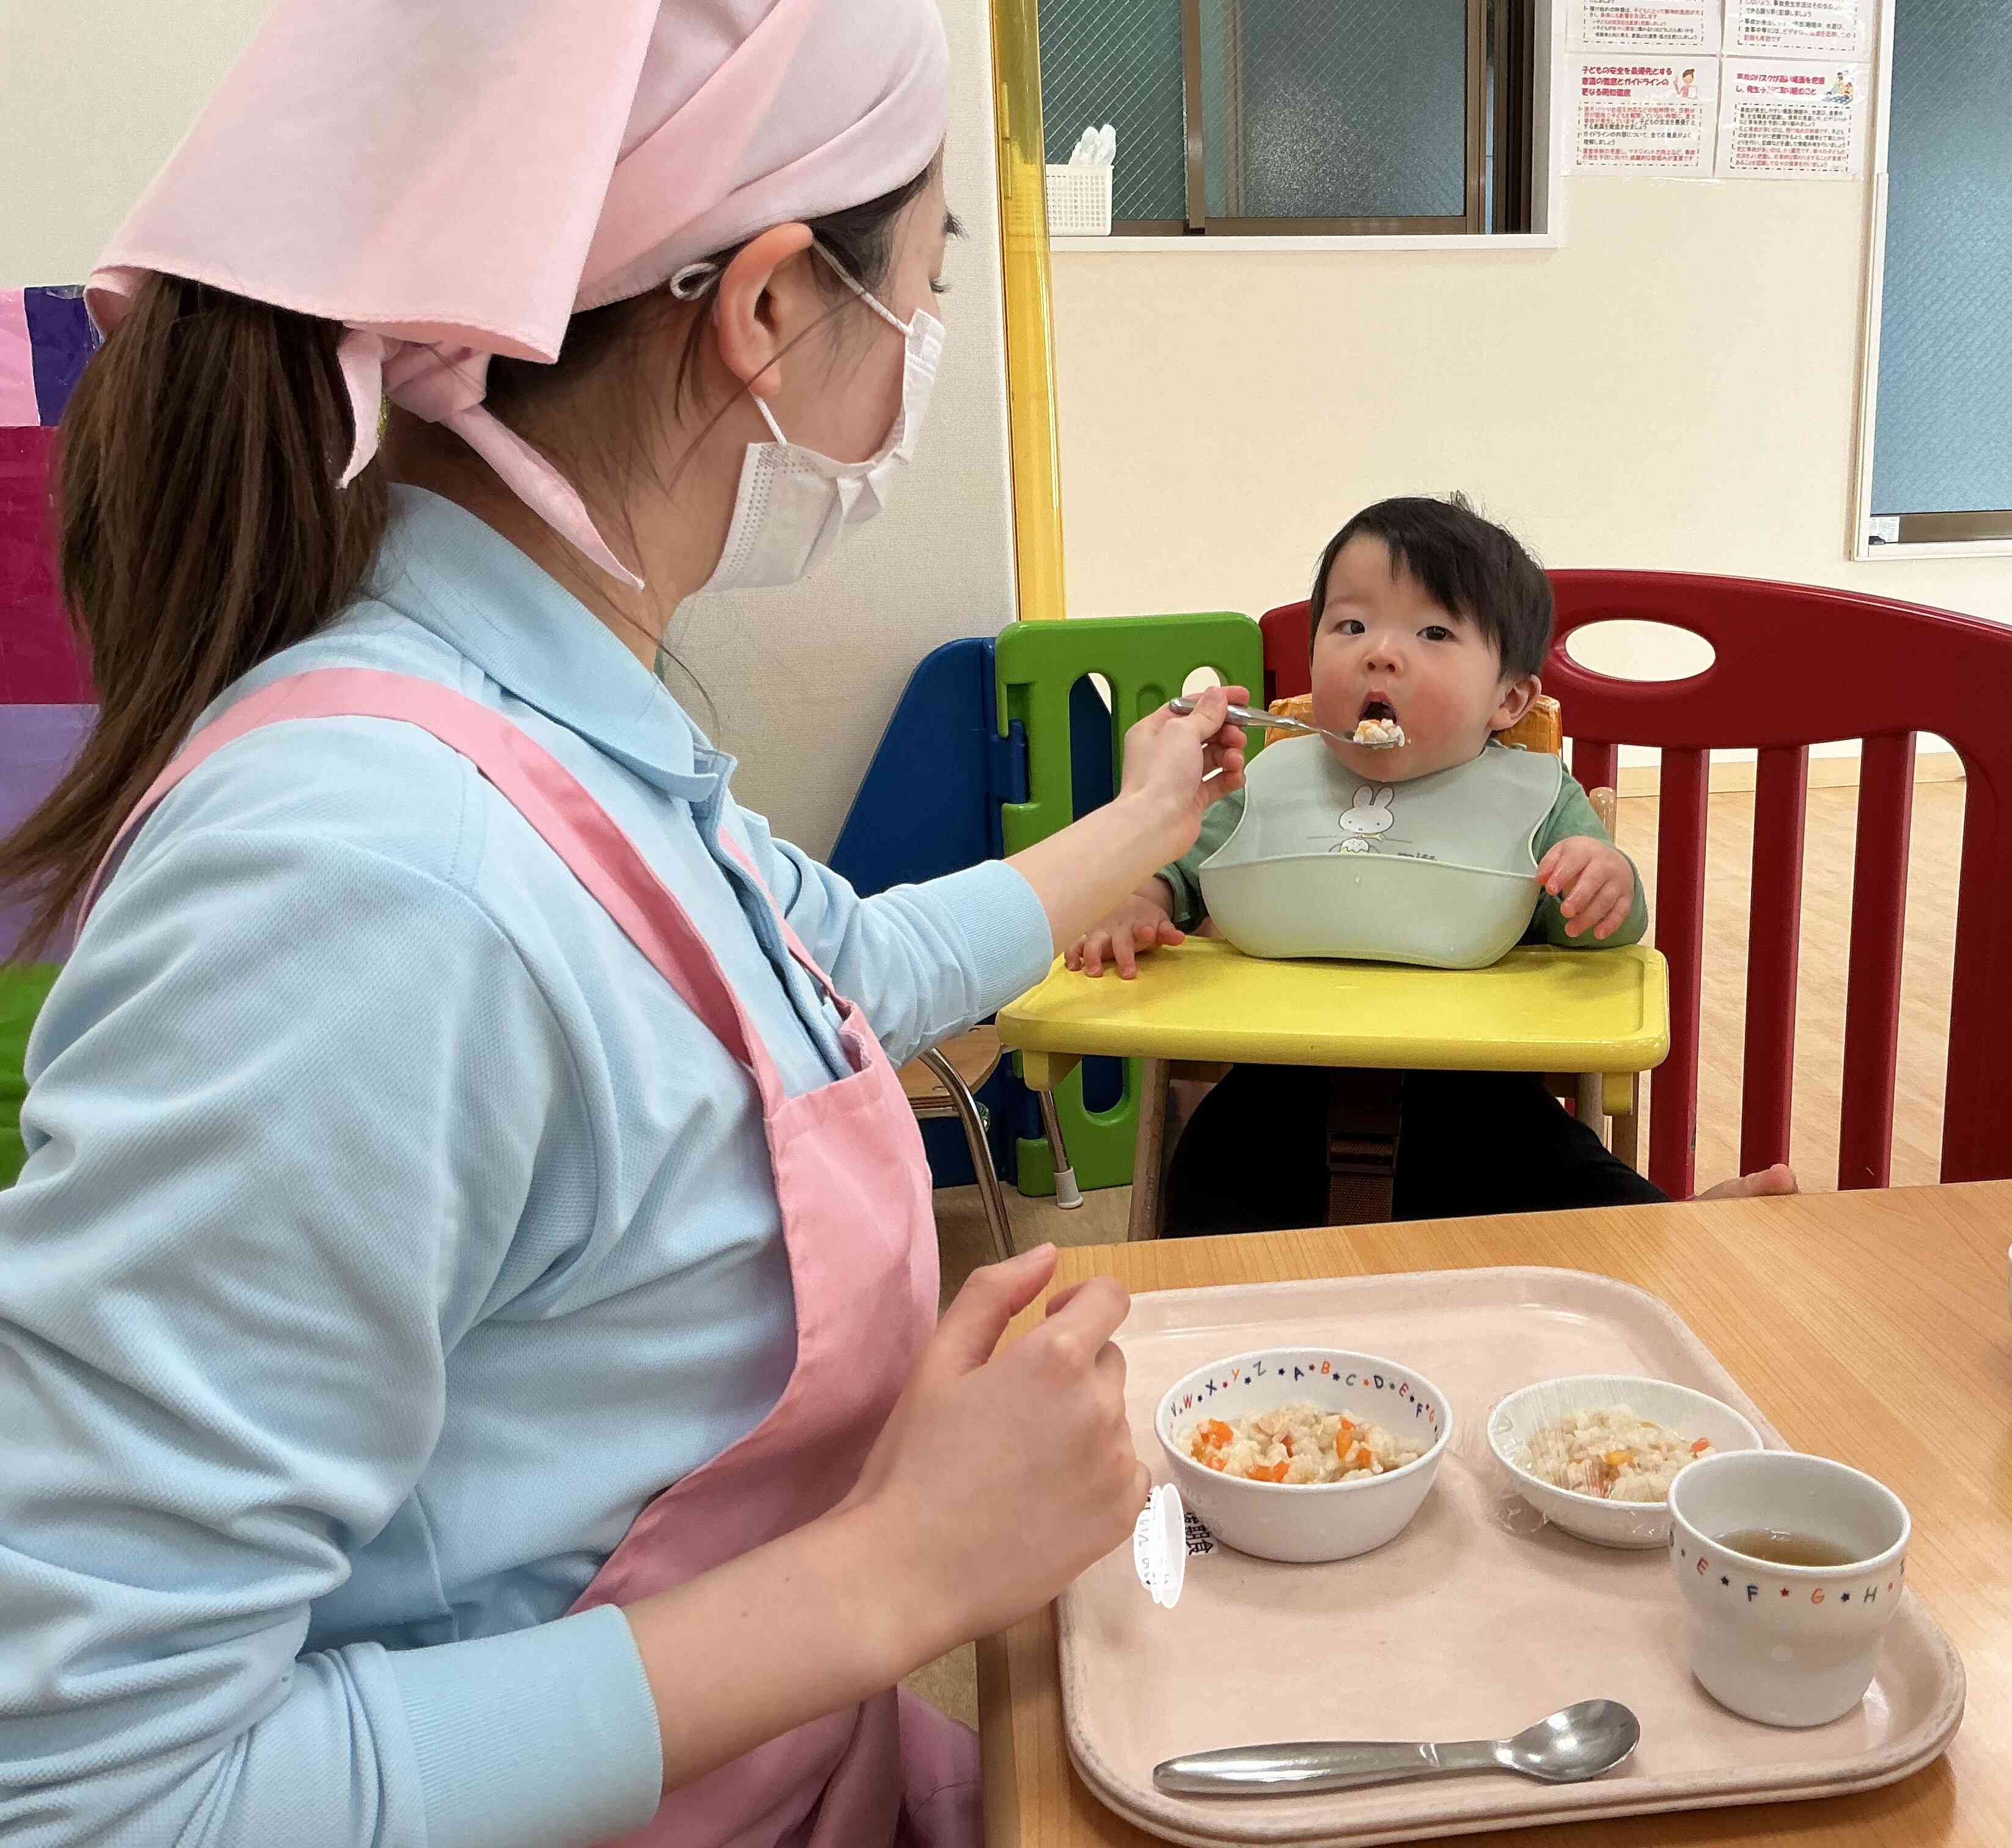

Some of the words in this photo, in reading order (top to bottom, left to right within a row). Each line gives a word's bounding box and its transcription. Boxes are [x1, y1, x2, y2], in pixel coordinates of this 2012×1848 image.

[1183, 1393, 1193, 1409] W
[1205, 1379, 1217, 1396] X
[1232, 1368, 1240, 1382] Y
[1252, 1360, 1266, 1376] Z
[1294, 1366, 1305, 1380] A
[1321, 1359, 1331, 1374] B
[1346, 1373, 1357, 1386] C
[1373, 1374, 1384, 1388] D
[1398, 1382, 1409, 1398] E
[1416, 1403, 1423, 1418] F
[1697, 1557, 1709, 1575] E
[1746, 1584, 1758, 1602] F
[1811, 1588, 1825, 1604] G
[1864, 1586, 1878, 1604] H
